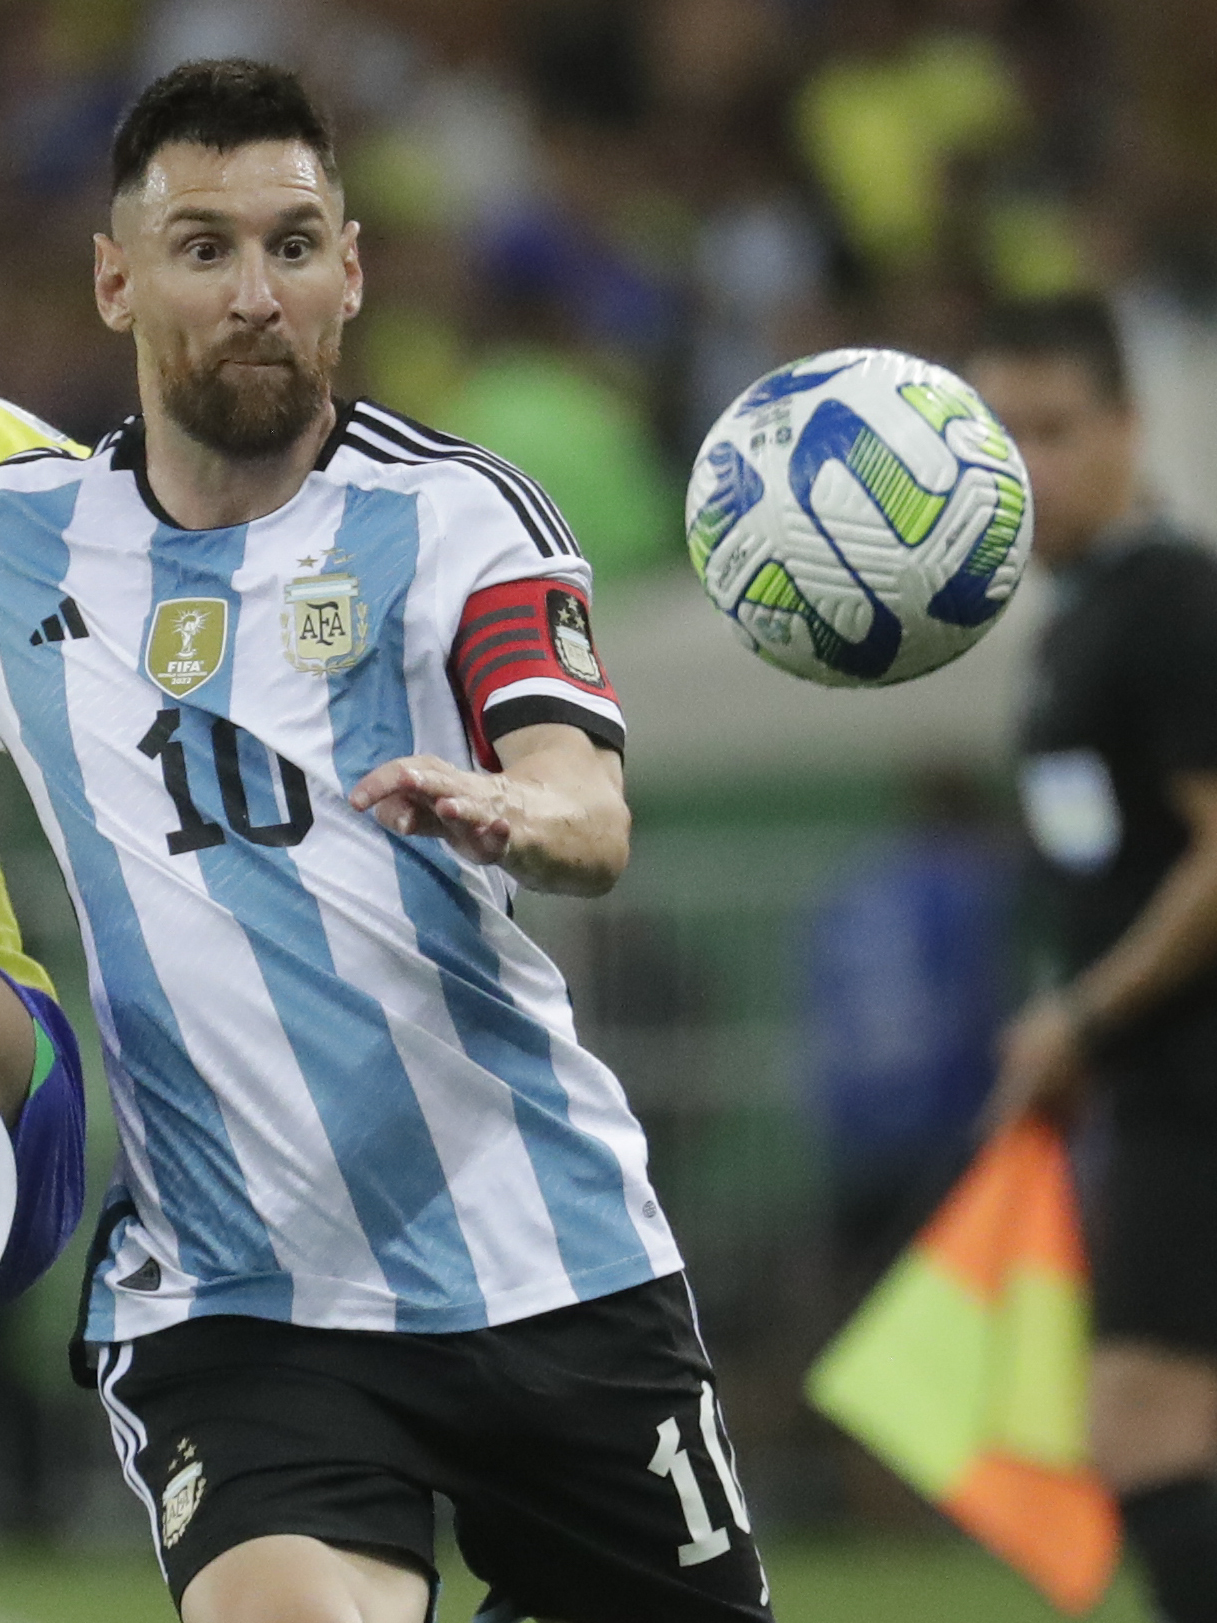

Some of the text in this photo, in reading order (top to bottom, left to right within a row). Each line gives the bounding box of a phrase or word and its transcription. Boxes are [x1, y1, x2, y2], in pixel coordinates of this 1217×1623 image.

[299, 601, 346, 646] AFA
[167, 660, 201, 673] FIFA
[137, 708, 315, 856] 10
